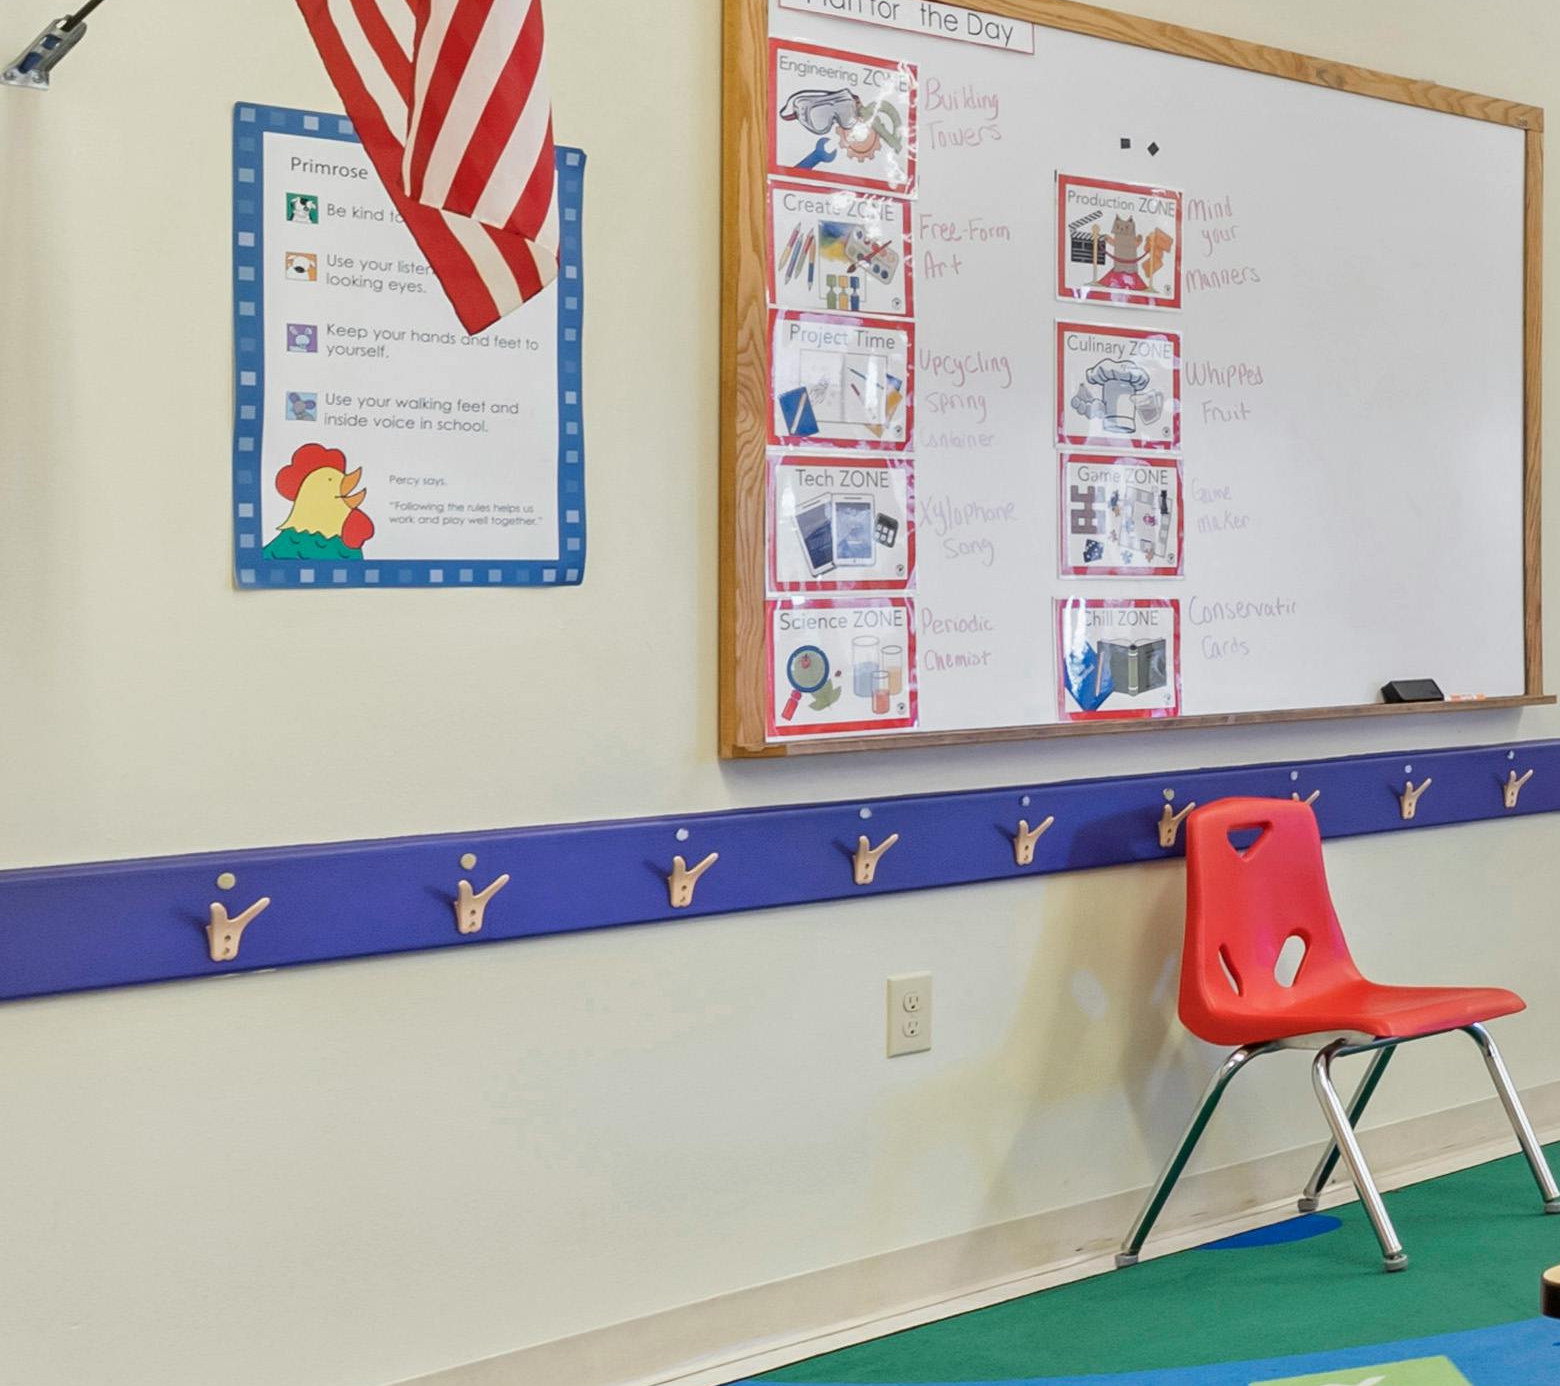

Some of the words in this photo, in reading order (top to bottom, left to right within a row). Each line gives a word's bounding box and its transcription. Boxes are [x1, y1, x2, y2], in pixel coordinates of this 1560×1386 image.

[920, 3, 959, 31] the
[967, 13, 1014, 47] Day
[779, 55, 858, 86] Engineering
[925, 77, 999, 119] Building
[926, 120, 1002, 150] Towers
[291, 156, 369, 180] Primrose
[326, 204, 346, 218] Be
[352, 204, 384, 222] kind
[1068, 189, 1135, 212] Production
[1138, 197, 1175, 217] ZONE
[1187, 196, 1233, 220] Mind
[919, 214, 1010, 241] Free-Form
[1201, 224, 1240, 257] your
[326, 254, 354, 268] Use
[360, 258, 393, 274] your
[924, 251, 963, 279] Art
[326, 273, 383, 293] looking
[388, 280, 427, 294] eyes.
[1186, 266, 1261, 293] Manners
[326, 323, 368, 340] Keep
[374, 329, 406, 344] your
[411, 330, 457, 345] hands
[461, 331, 490, 347] and
[494, 334, 522, 349] feet
[526, 338, 540, 351] to
[790, 324, 849, 346] Project
[856, 330, 896, 350] Time
[1067, 335, 1126, 359] Culinary
[1129, 341, 1172, 359] ZONE
[326, 343, 390, 359] yourself.
[919, 349, 1013, 388] Upcycling
[1185, 362, 1264, 388] Whipped
[325, 393, 352, 406] Use
[358, 395, 391, 411] your
[395, 397, 452, 413] walking
[456, 400, 486, 414] feet
[490, 402, 519, 415] and
[927, 391, 988, 423] Spring
[1202, 400, 1251, 424] Fruit
[324, 414, 368, 428] inside
[373, 416, 415, 430] voice
[420, 416, 433, 430] in
[437, 418, 488, 433] school.
[389, 475, 419, 488] Percy
[795, 469, 835, 488] Tech
[839, 470, 890, 488] ZONE
[1077, 466, 1121, 484] Game
[1125, 469, 1168, 485] ZONE
[448, 502, 464, 513] the
[467, 503, 491, 514] rules
[493, 503, 521, 515] helps
[523, 505, 534, 515] us
[920, 495, 1020, 537] Xylophone
[389, 515, 414, 525] work
[417, 515, 439, 525] and
[442, 515, 465, 527] play
[468, 515, 488, 526] well
[943, 537, 995, 566] Song
[780, 613, 849, 631] Science
[853, 610, 903, 629] ZONE
[921, 608, 993, 634] Periodic
[1085, 610, 1113, 627] Chill
[1118, 610, 1159, 627] ZONE
[924, 649, 992, 671] Chemist
